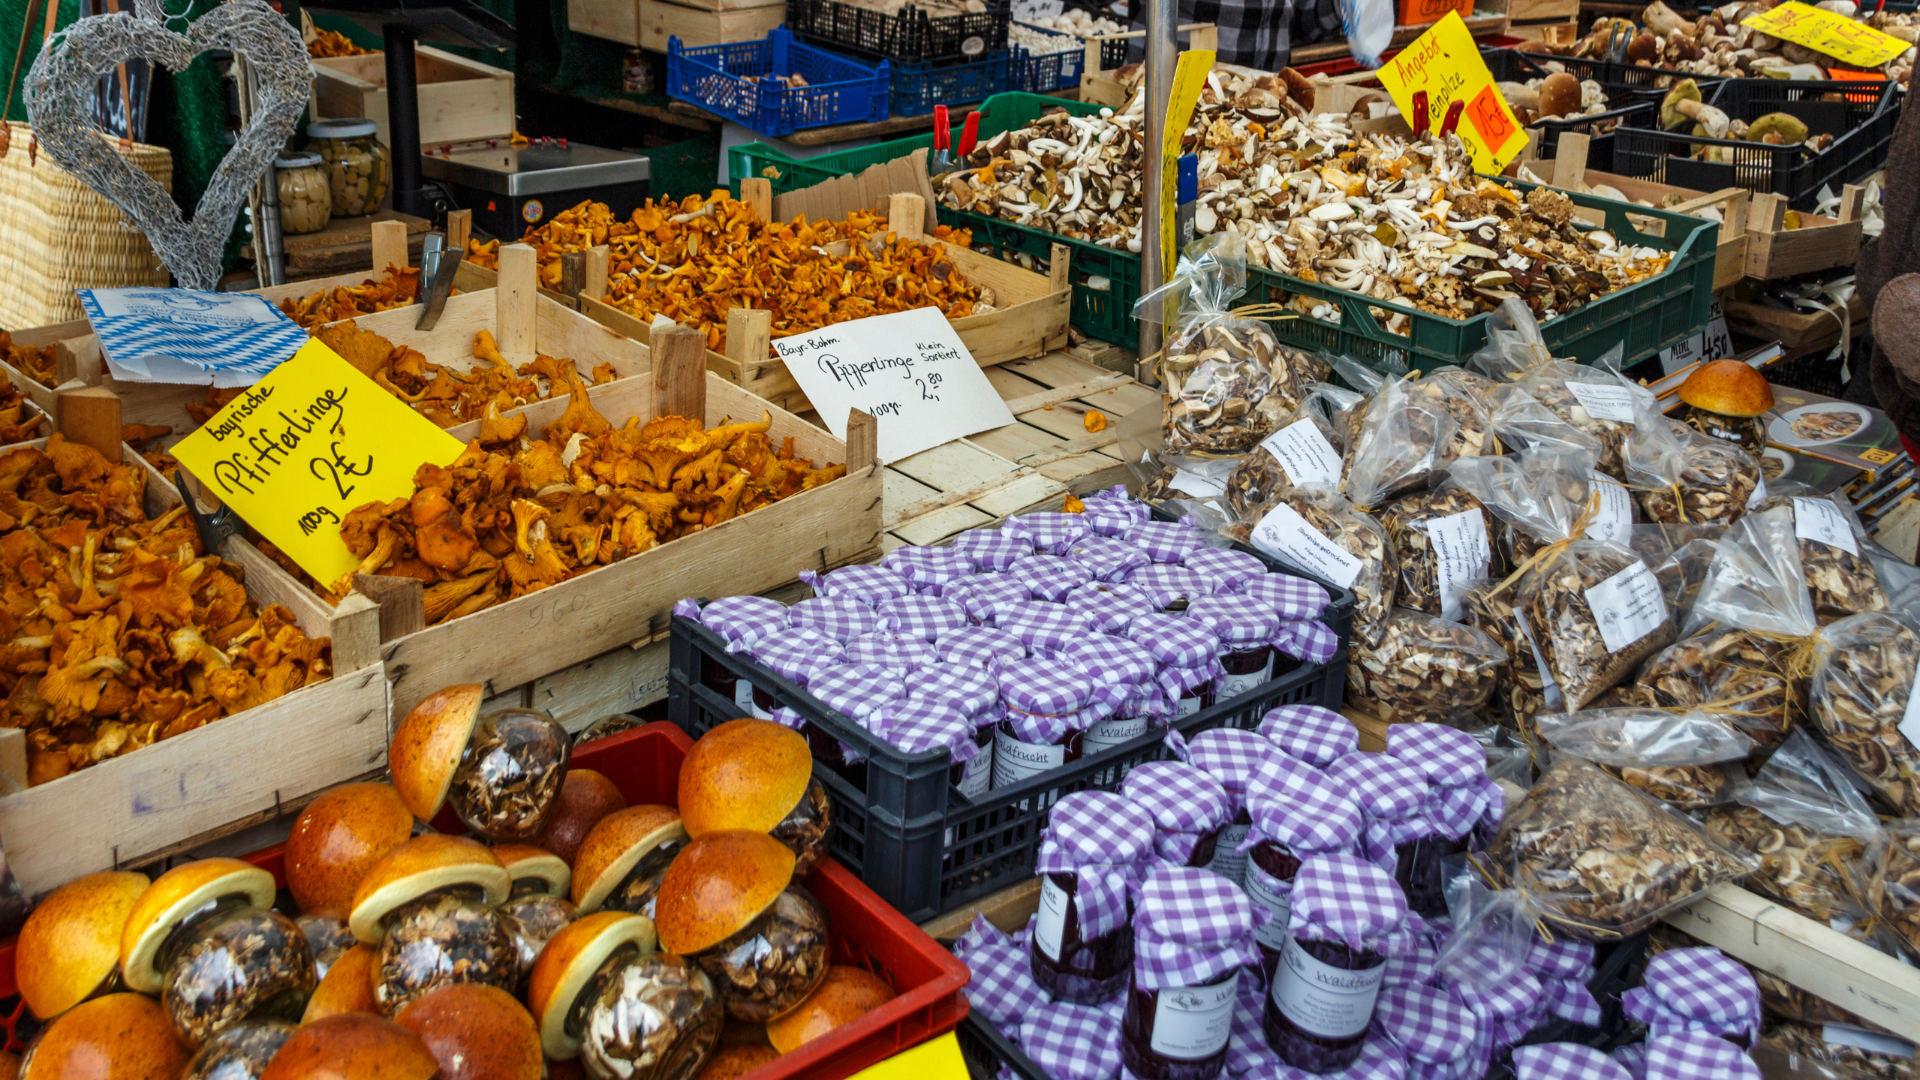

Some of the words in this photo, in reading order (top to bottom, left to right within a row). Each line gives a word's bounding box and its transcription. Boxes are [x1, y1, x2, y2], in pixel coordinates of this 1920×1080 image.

[1476, 96, 1509, 140] 15€
[915, 342, 945, 352] Klein
[817, 354, 915, 391] Pfifferlinge
[920, 347, 961, 362] Sortiert
[205, 385, 275, 442] bayrische
[214, 386, 348, 495] Pfifferlinge
[1866, 448, 1889, 461] GU
[309, 441, 374, 500] 2€
[298, 506, 340, 536] 100g
[529, 593, 586, 630] 960
[999, 740, 1050, 764] aldfrucht
